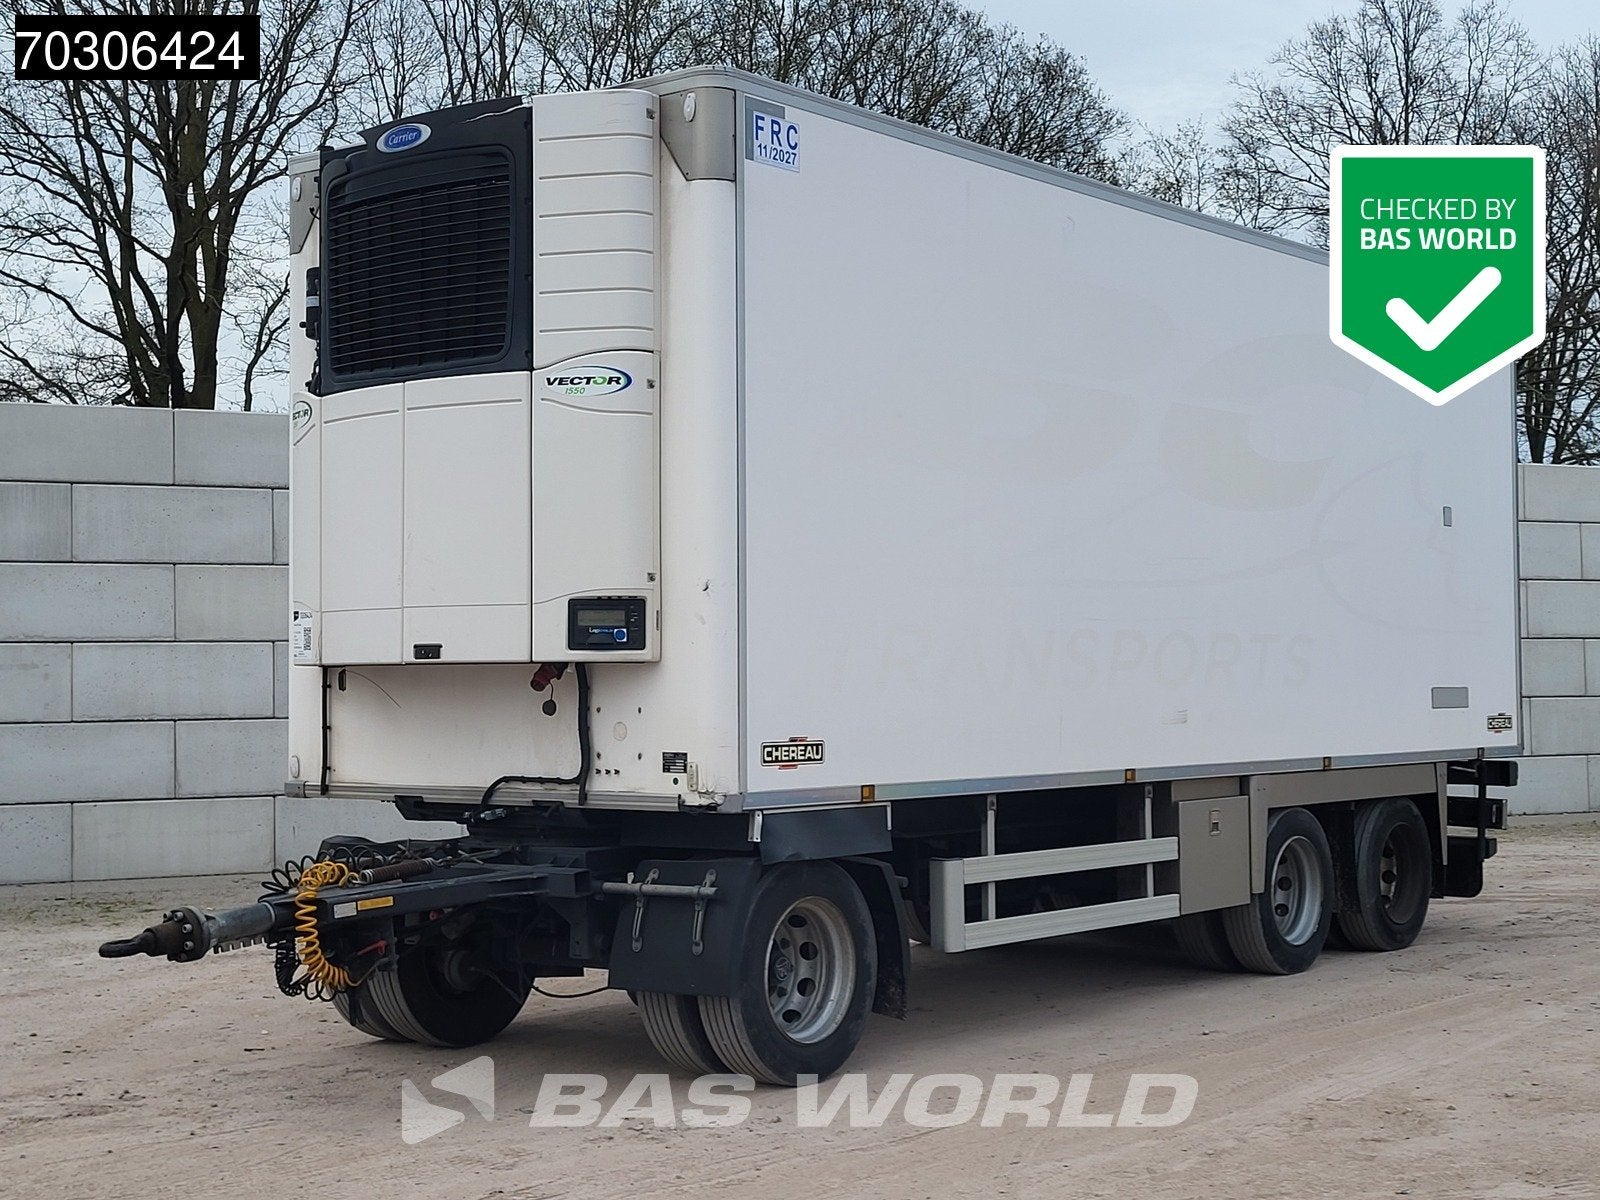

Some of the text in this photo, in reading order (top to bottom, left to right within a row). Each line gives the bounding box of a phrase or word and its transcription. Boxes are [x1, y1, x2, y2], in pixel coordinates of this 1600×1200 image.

[388, 131, 418, 146] Carrier
[754, 114, 798, 151] FRC
[757, 143, 797, 166] 11/2027
[545, 376, 622, 386] VECTOR
[565, 387, 586, 395] 1550
[764, 745, 822, 761] CHEREAU
